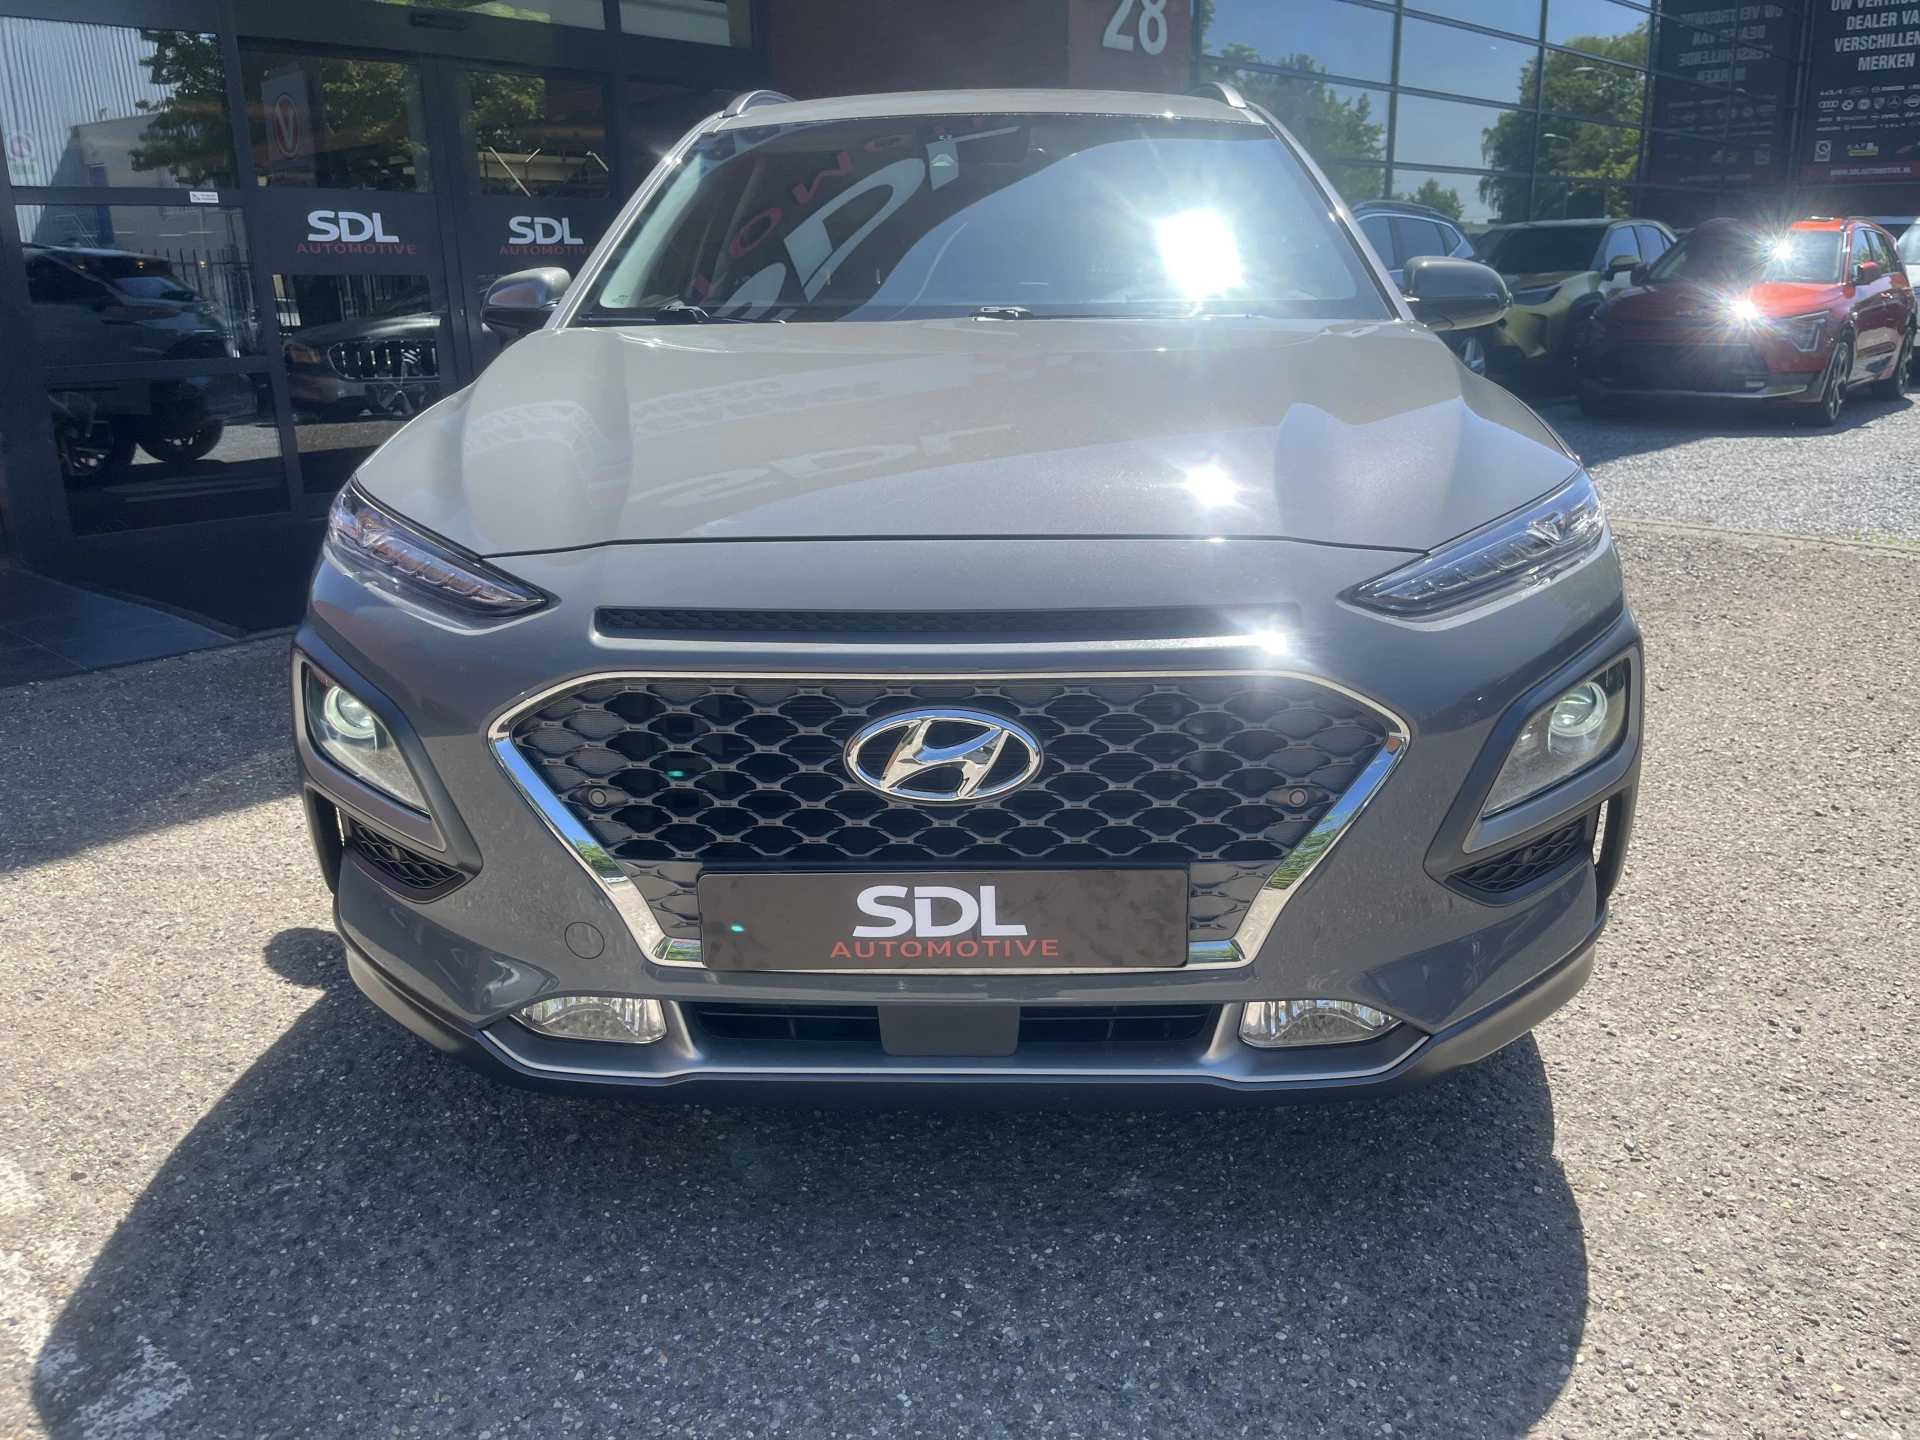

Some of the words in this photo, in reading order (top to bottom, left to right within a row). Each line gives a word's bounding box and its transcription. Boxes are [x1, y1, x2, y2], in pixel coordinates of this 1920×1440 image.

[1102, 0, 1168, 55] 28
[1846, 12, 1897, 30] DEALER
[1902, 9, 1920, 25] VA
[1858, 53, 1915, 71] MERKEN
[307, 210, 400, 243] SDL
[508, 216, 584, 245] SDL
[296, 243, 416, 255] AUTOMOTIVE
[852, 885, 1028, 938] SDL
[830, 938, 1059, 959] AUTOMOTIVE
